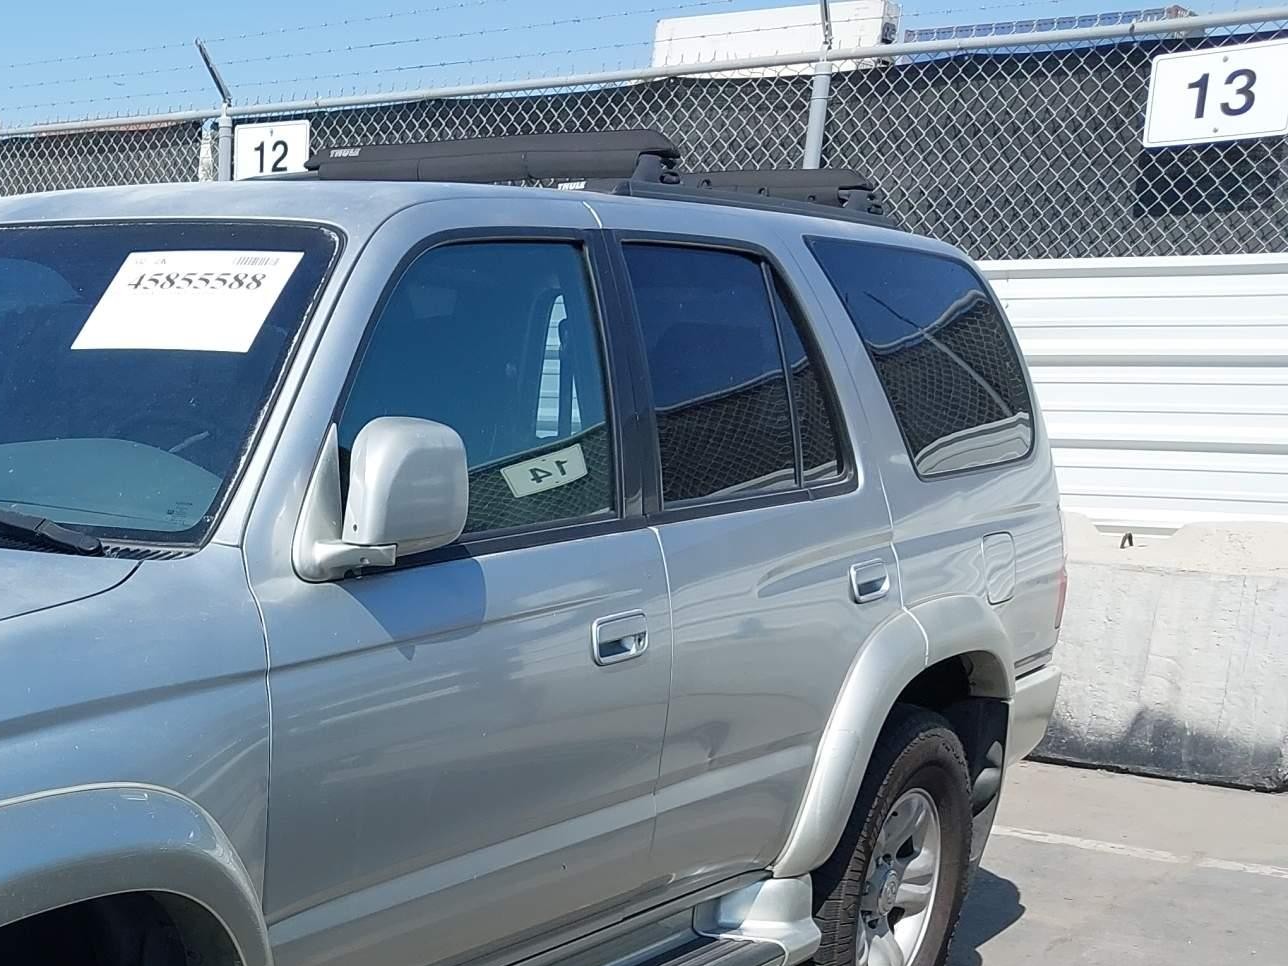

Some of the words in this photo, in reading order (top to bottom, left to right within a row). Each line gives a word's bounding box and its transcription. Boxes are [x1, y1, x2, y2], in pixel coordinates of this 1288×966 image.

[1187, 68, 1257, 120] 13
[253, 140, 289, 174] 12
[128, 272, 267, 290] 45855588
